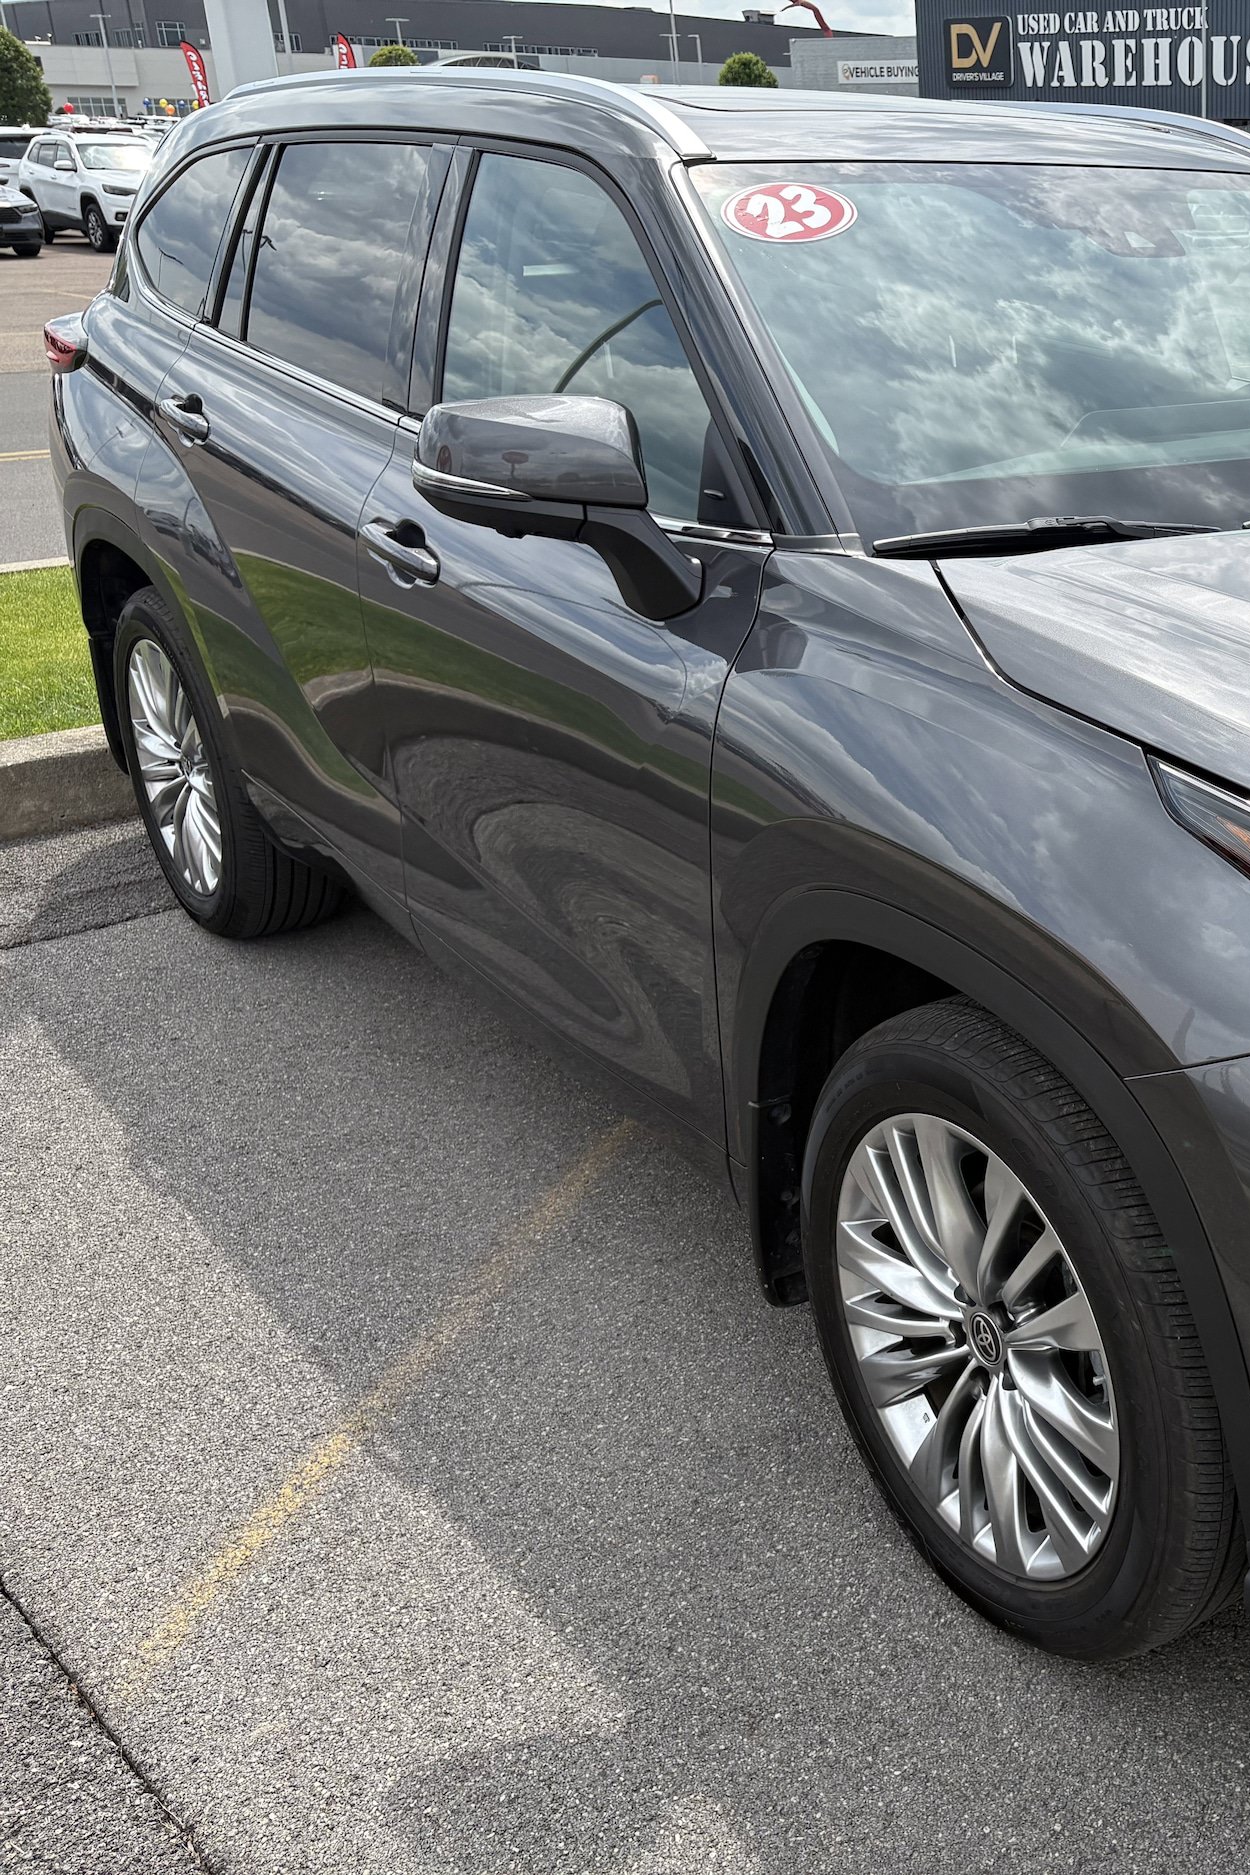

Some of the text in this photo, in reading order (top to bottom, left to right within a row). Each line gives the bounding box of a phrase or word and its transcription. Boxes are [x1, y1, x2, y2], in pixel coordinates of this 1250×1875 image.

[1017, 6, 1209, 35] USED CAR AND TRUCK
[950, 22, 1002, 68] DV
[850, 65, 887, 78] VEHICLE
[979, 71, 1005, 81] VILLAGE
[745, 185, 832, 239] 23
